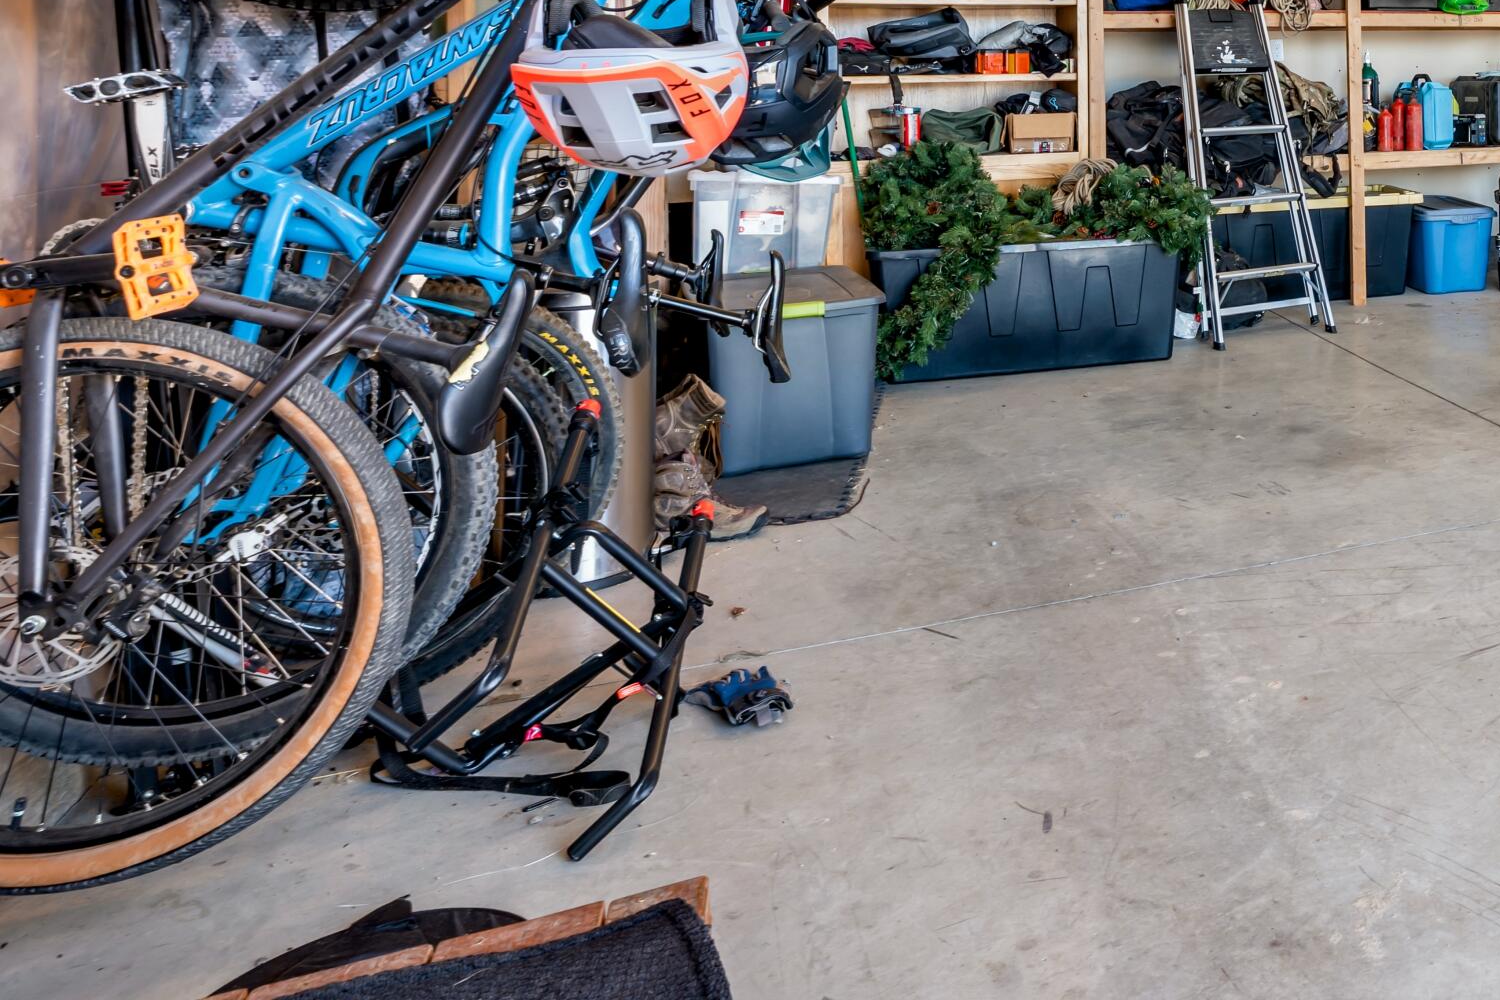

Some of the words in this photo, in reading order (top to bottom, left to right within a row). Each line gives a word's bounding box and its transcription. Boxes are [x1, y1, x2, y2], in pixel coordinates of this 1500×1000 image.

[668, 77, 711, 119] FOX
[147, 146, 164, 179] SLX
[61, 347, 234, 383] MAXXIS
[538, 331, 601, 396] MAXXIS
